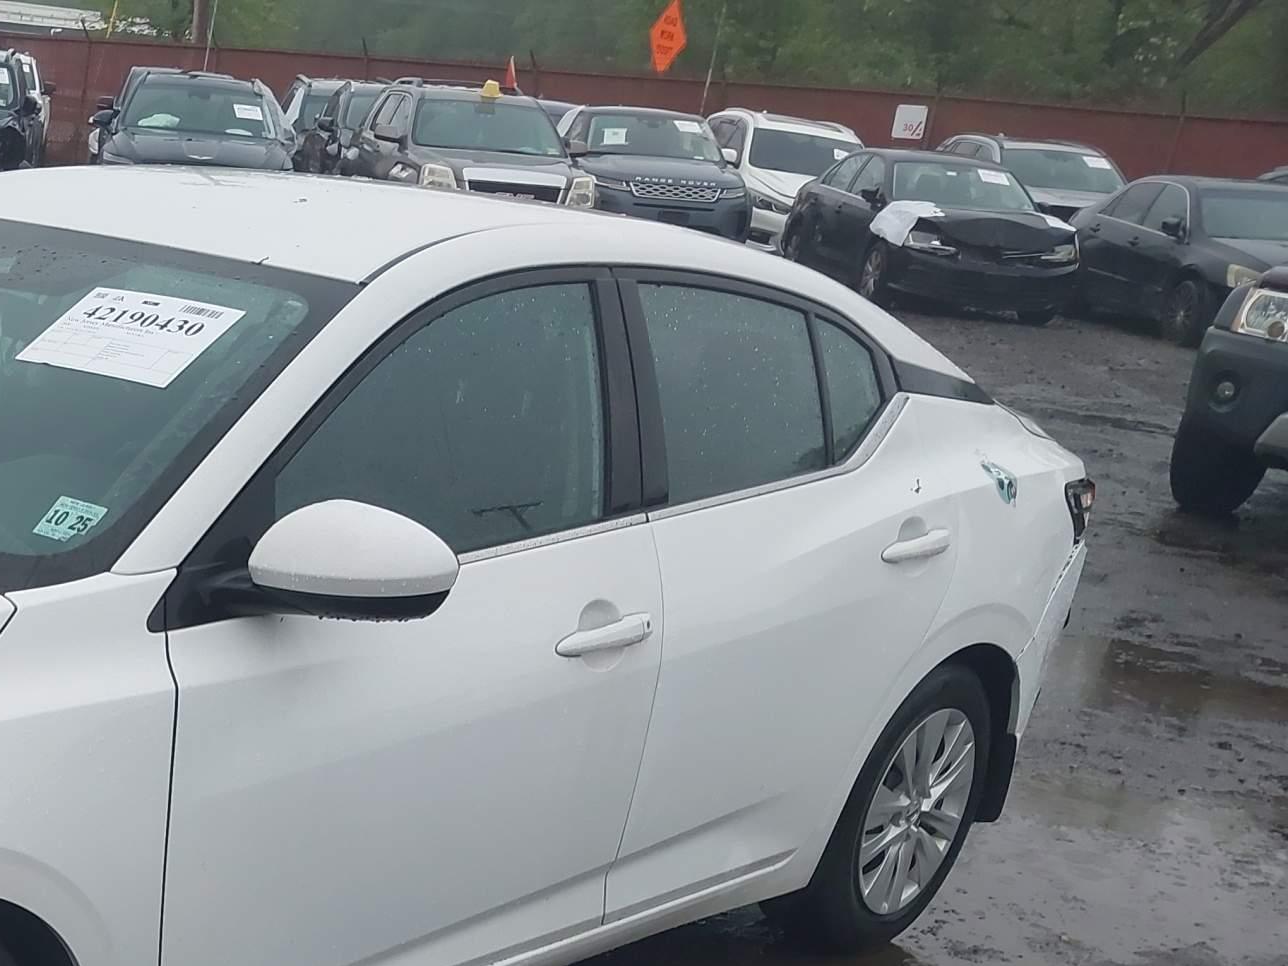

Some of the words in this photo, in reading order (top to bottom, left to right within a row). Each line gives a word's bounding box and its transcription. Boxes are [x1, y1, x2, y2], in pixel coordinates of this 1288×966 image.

[635, 176, 673, 184] RANGE
[680, 179, 717, 187] ROVER
[82, 304, 205, 337] 42190430
[45, 508, 70, 527] 10
[67, 515, 93, 533] 25
